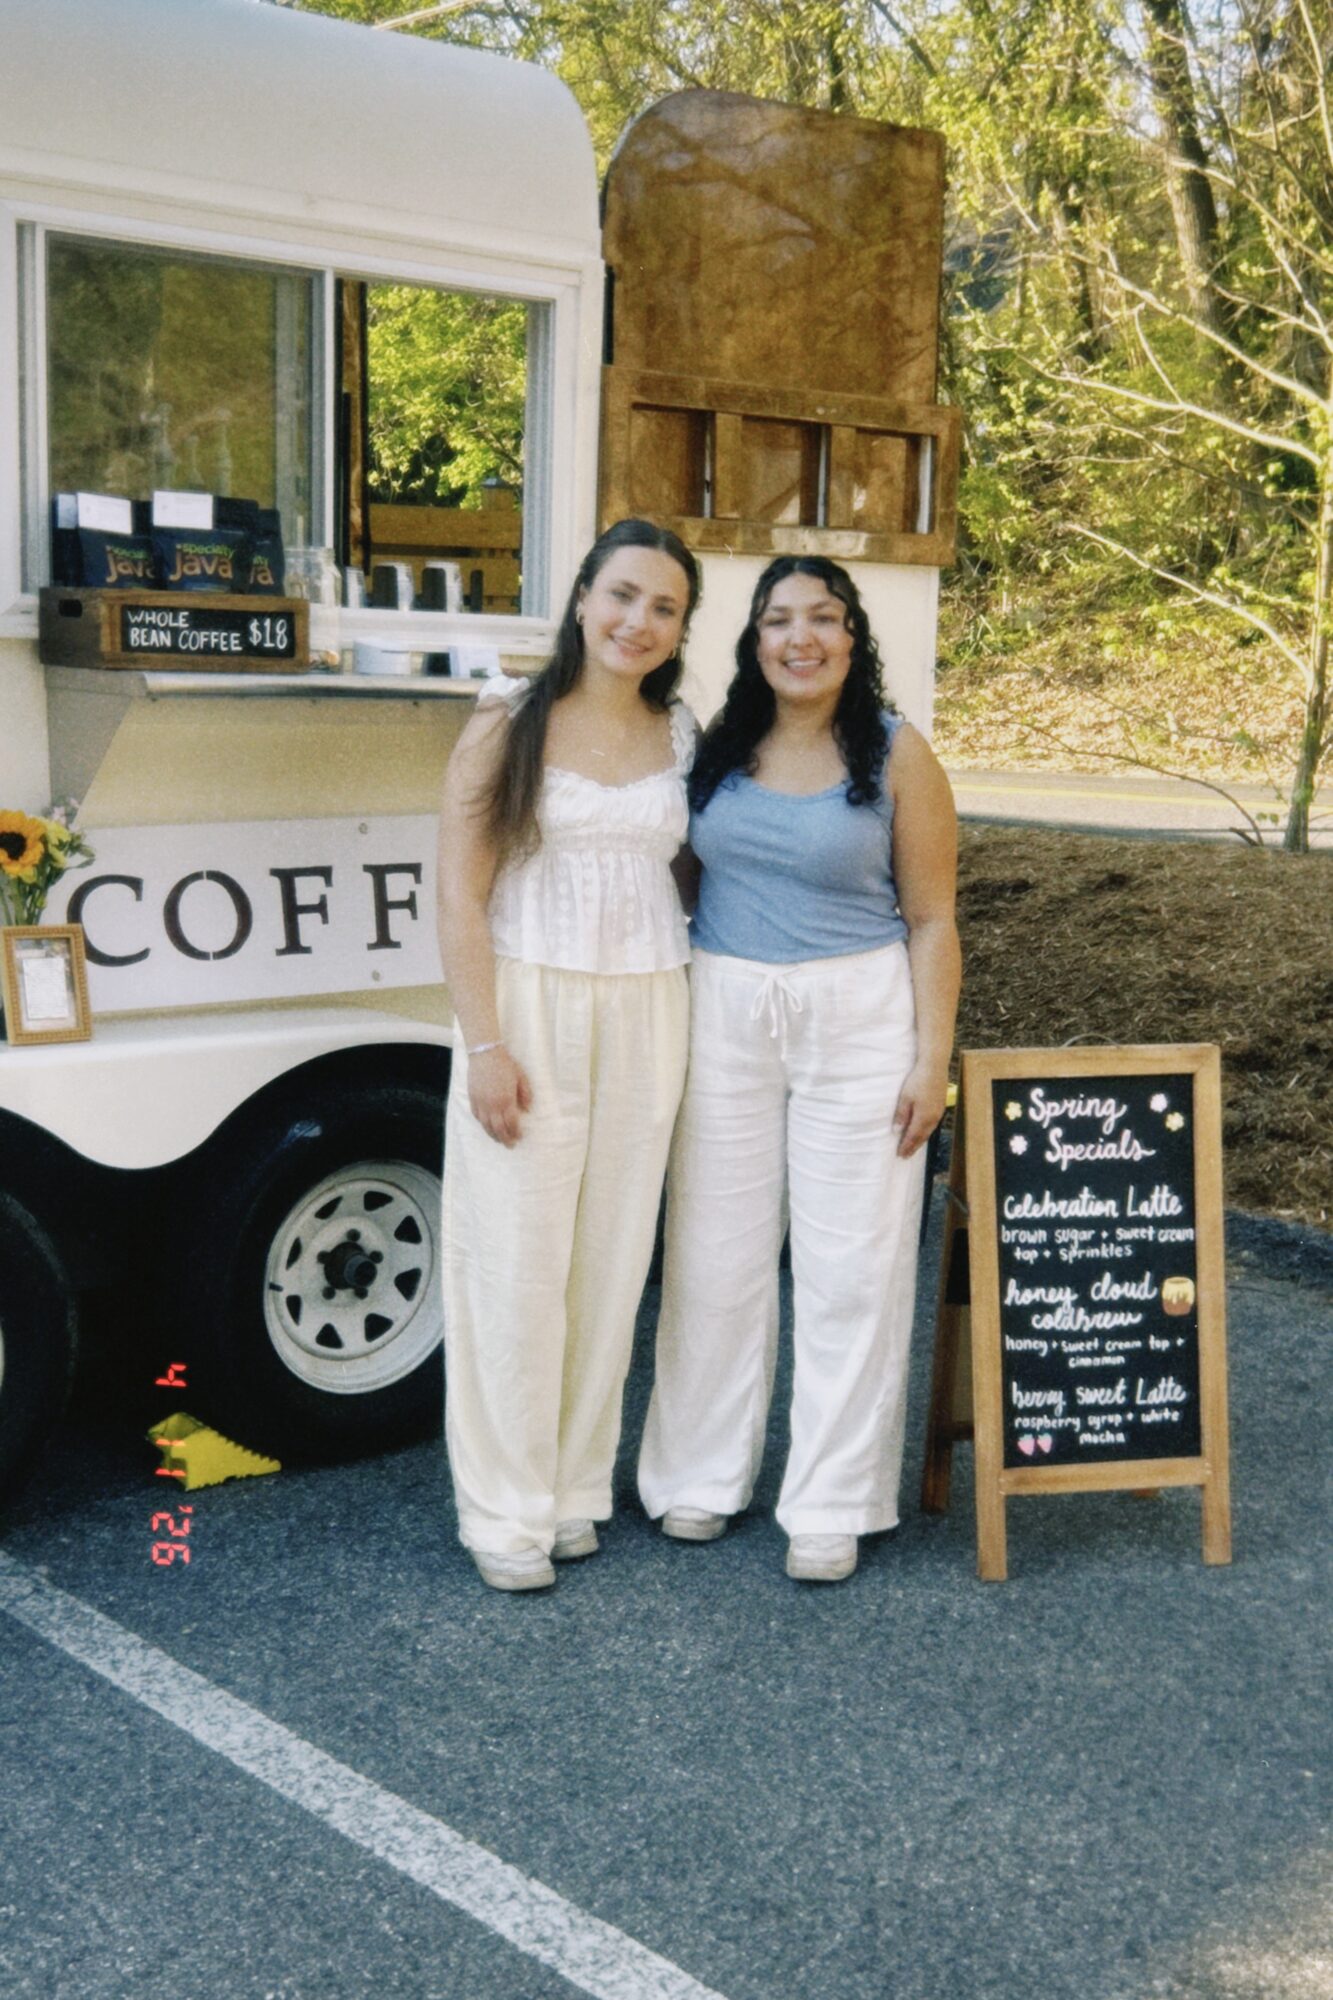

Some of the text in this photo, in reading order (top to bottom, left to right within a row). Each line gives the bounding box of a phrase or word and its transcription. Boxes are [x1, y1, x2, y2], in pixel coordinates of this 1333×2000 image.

[169, 544, 233, 581] java
[128, 611, 189, 627] WHOLE
[130, 628, 242, 651] BEAN COFFEE
[250, 618, 288, 649] $18
[1029, 1088, 1127, 1135] Spring
[1045, 1128, 1155, 1171] Specials
[1004, 1185, 1182, 1219] Celebration Latte
[1001, 1225, 1047, 1243] brown
[1055, 1228, 1095, 1248] sugar
[1116, 1226, 1155, 1241] sweet
[1158, 1227, 1194, 1242] cream
[1014, 1247, 1038, 1264] top
[1060, 1244, 1133, 1263] sprinkles
[1004, 1271, 1157, 1311] honey cloud
[1032, 1307, 1142, 1332] coldbrew
[1005, 1335, 1048, 1357] honey
[1061, 1337, 1099, 1352] sweet
[1105, 1340, 1142, 1352] cream
[1149, 1335, 1170, 1351] top
[1068, 1355, 1125, 1368] cinnamon
[1136, 1376, 1187, 1405] Latte
[1014, 1415, 1080, 1432] raspberry
[1088, 1413, 1122, 1430] syrup
[1141, 1410, 1179, 1422] white
[1079, 1431, 1125, 1445] mocha
